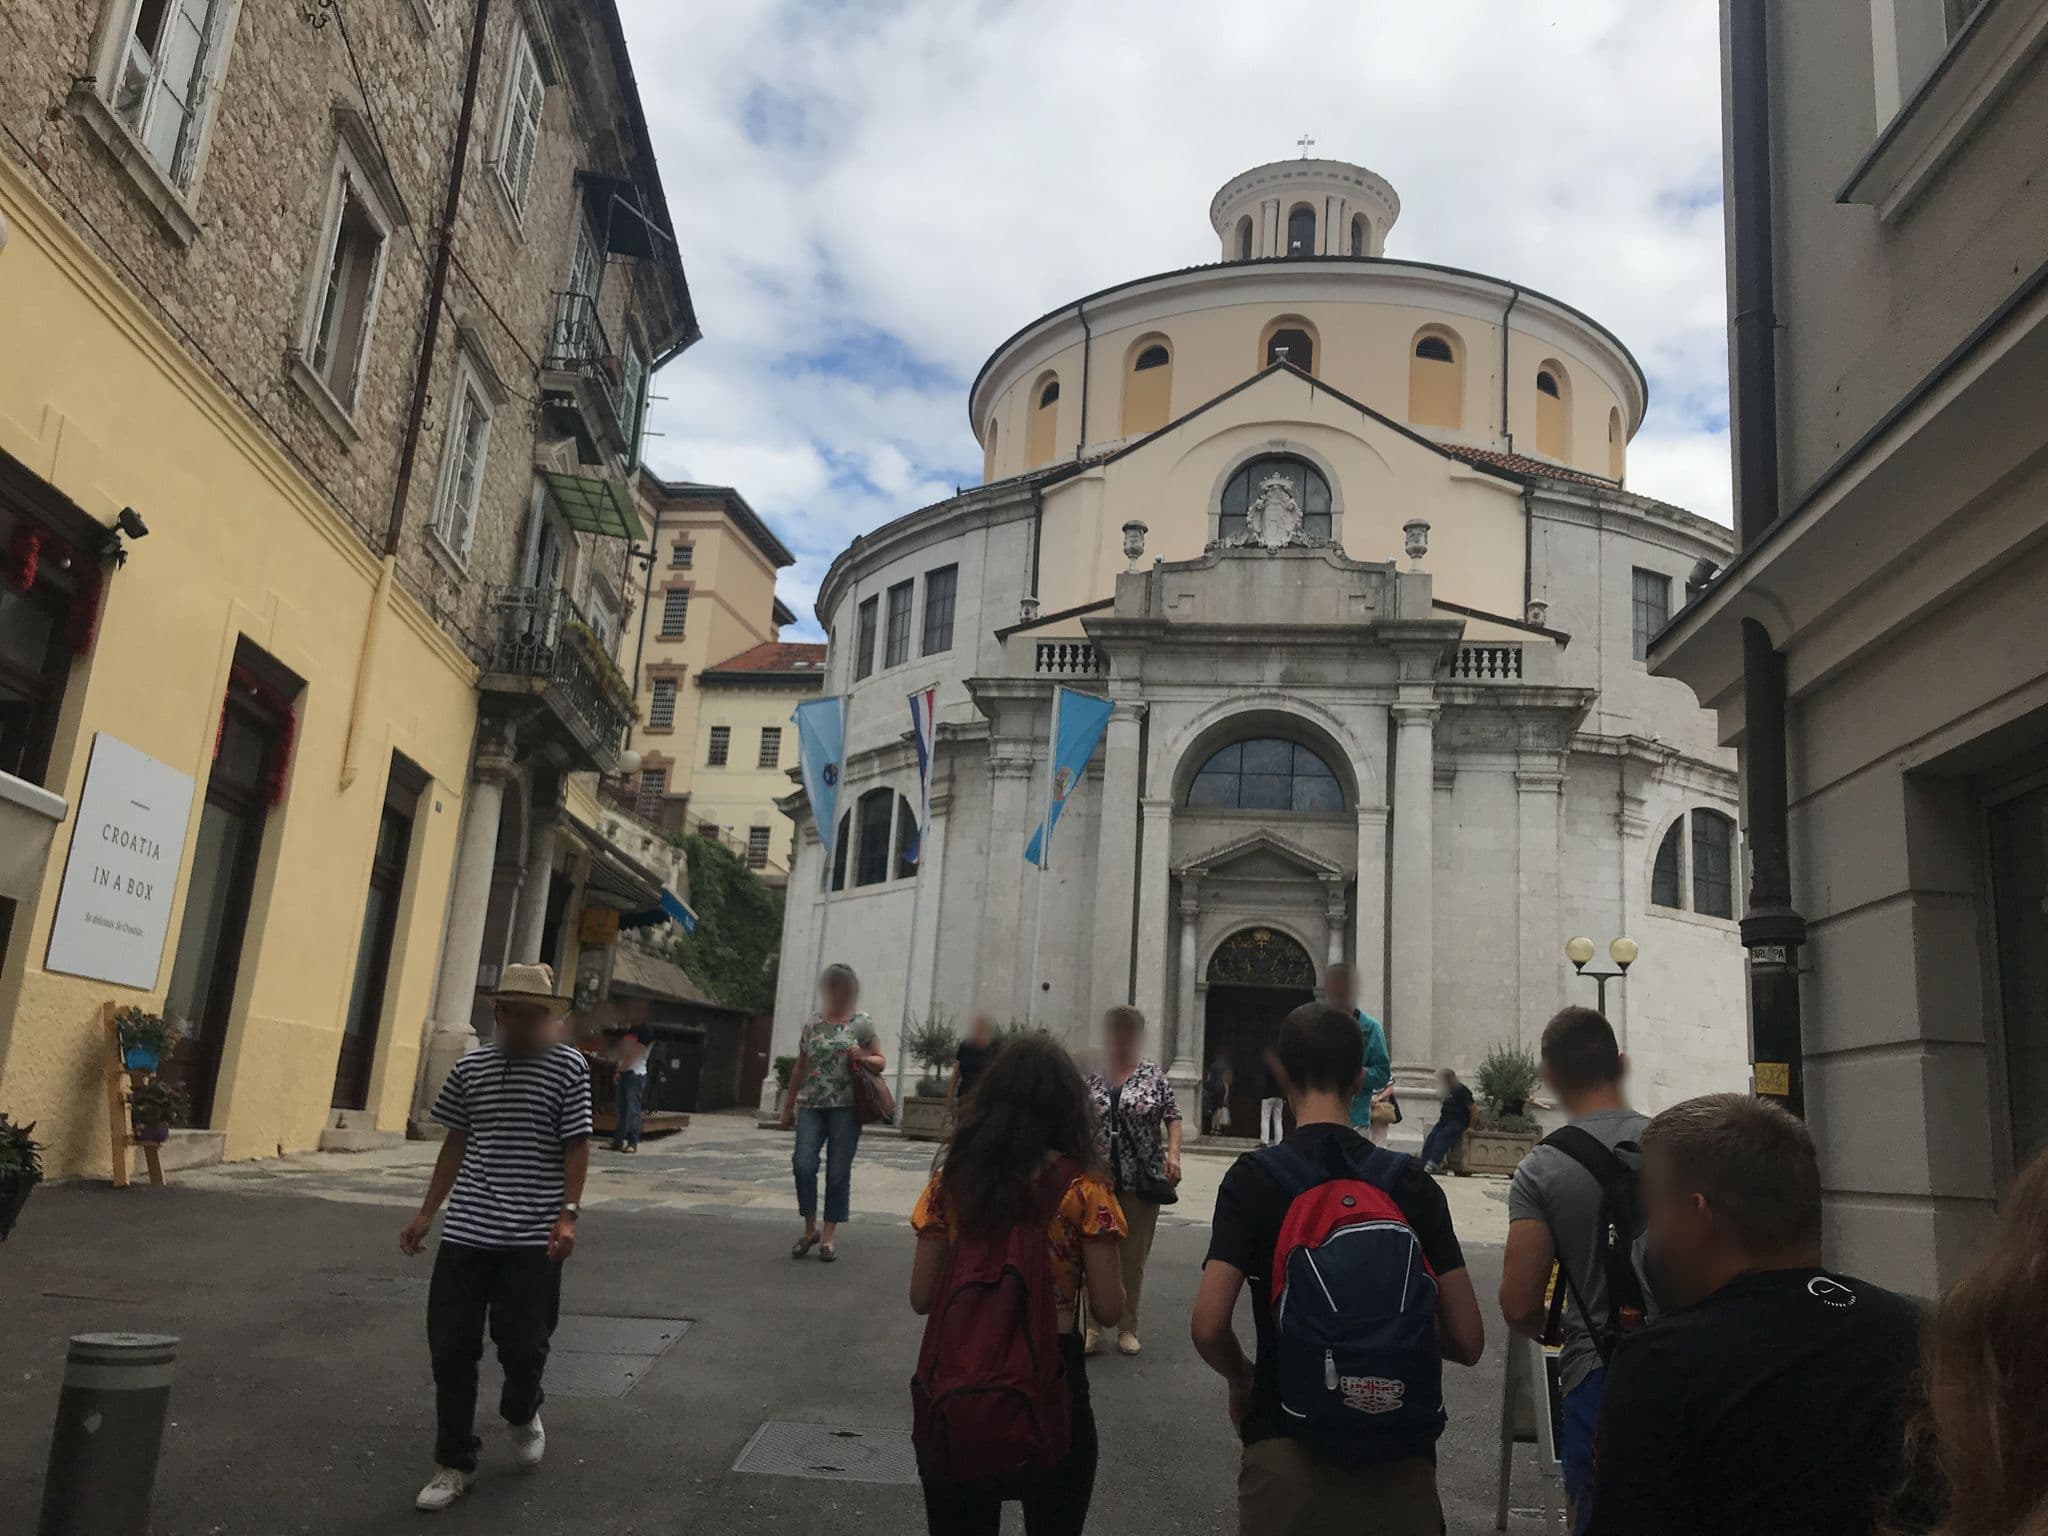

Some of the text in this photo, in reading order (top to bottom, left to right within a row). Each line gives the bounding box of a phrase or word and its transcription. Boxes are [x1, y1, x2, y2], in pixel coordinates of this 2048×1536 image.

[102, 824, 160, 861] CROATIA
[93, 865, 154, 902] IN A BOX
